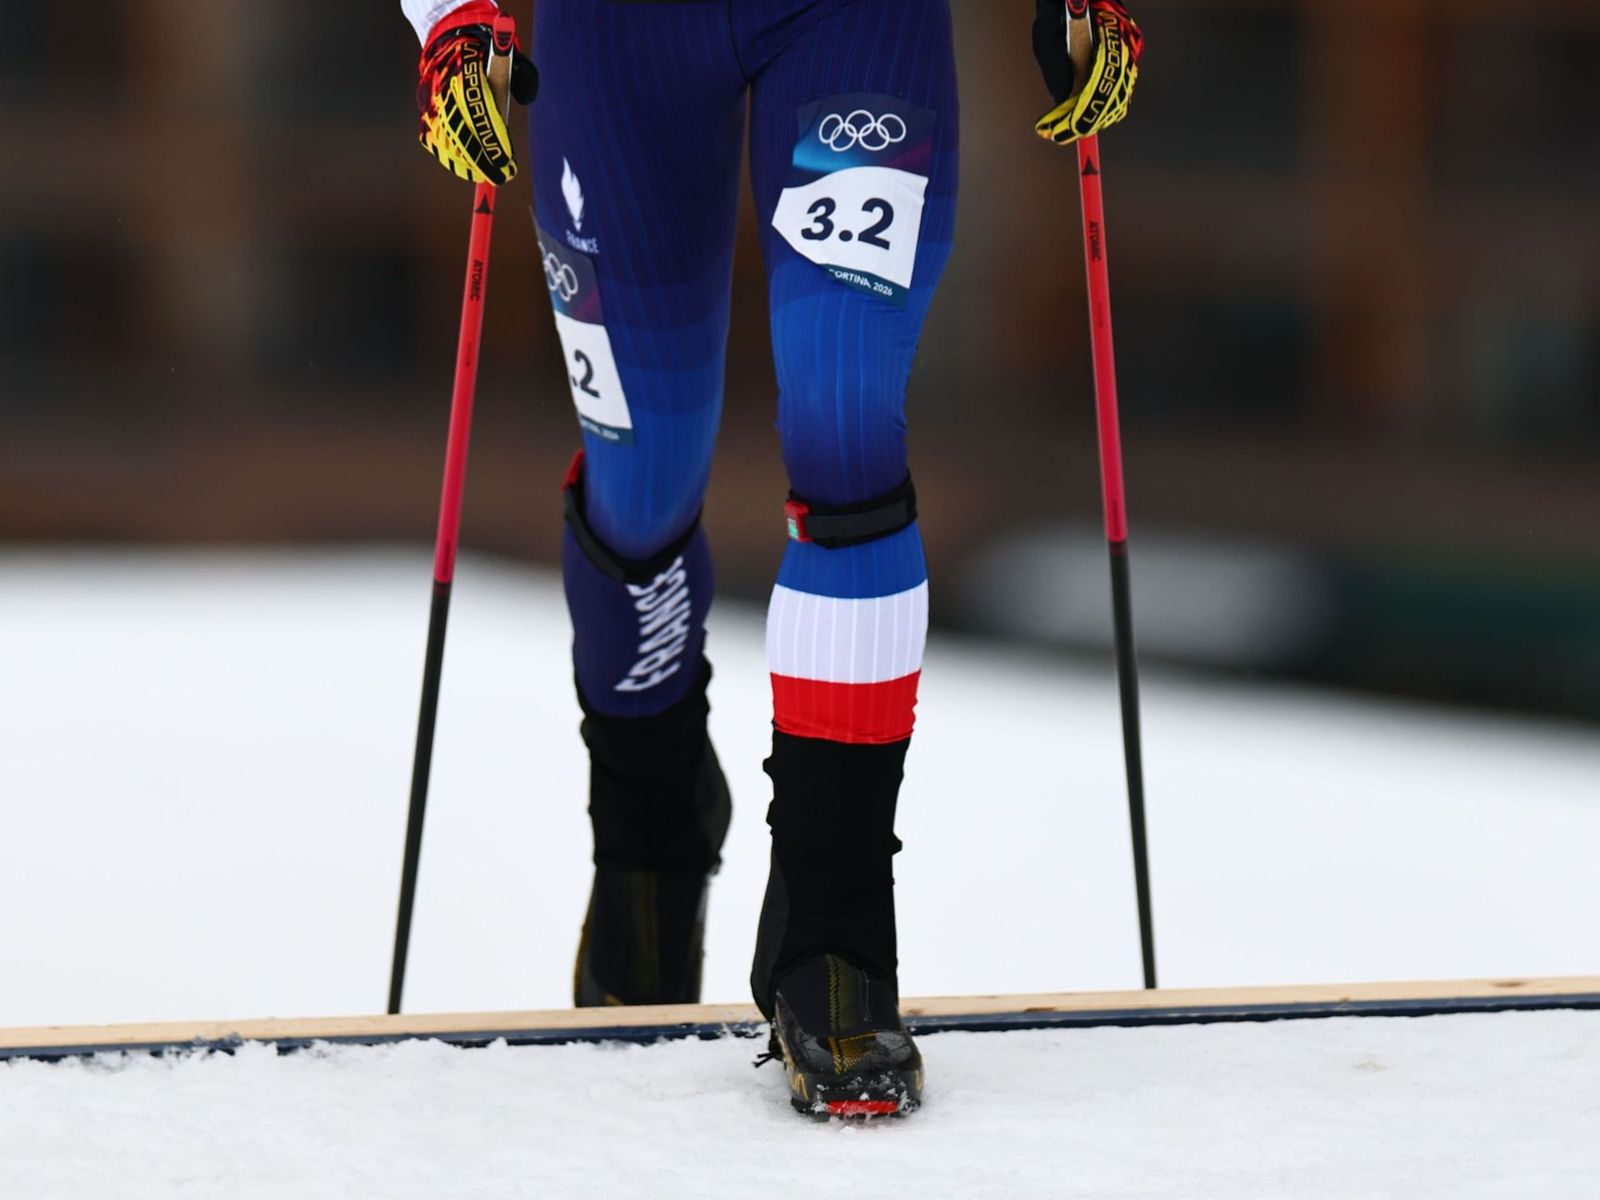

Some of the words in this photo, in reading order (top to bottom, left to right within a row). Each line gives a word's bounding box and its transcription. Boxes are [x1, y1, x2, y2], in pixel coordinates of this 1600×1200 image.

[463, 41, 480, 61] LA
[464, 61, 502, 161] SPORTIVA
[1083, 100, 1105, 124] LA
[801, 197, 894, 251] 3.2
[873, 282, 893, 297] 2026
[614, 555, 692, 692] FRANCE
